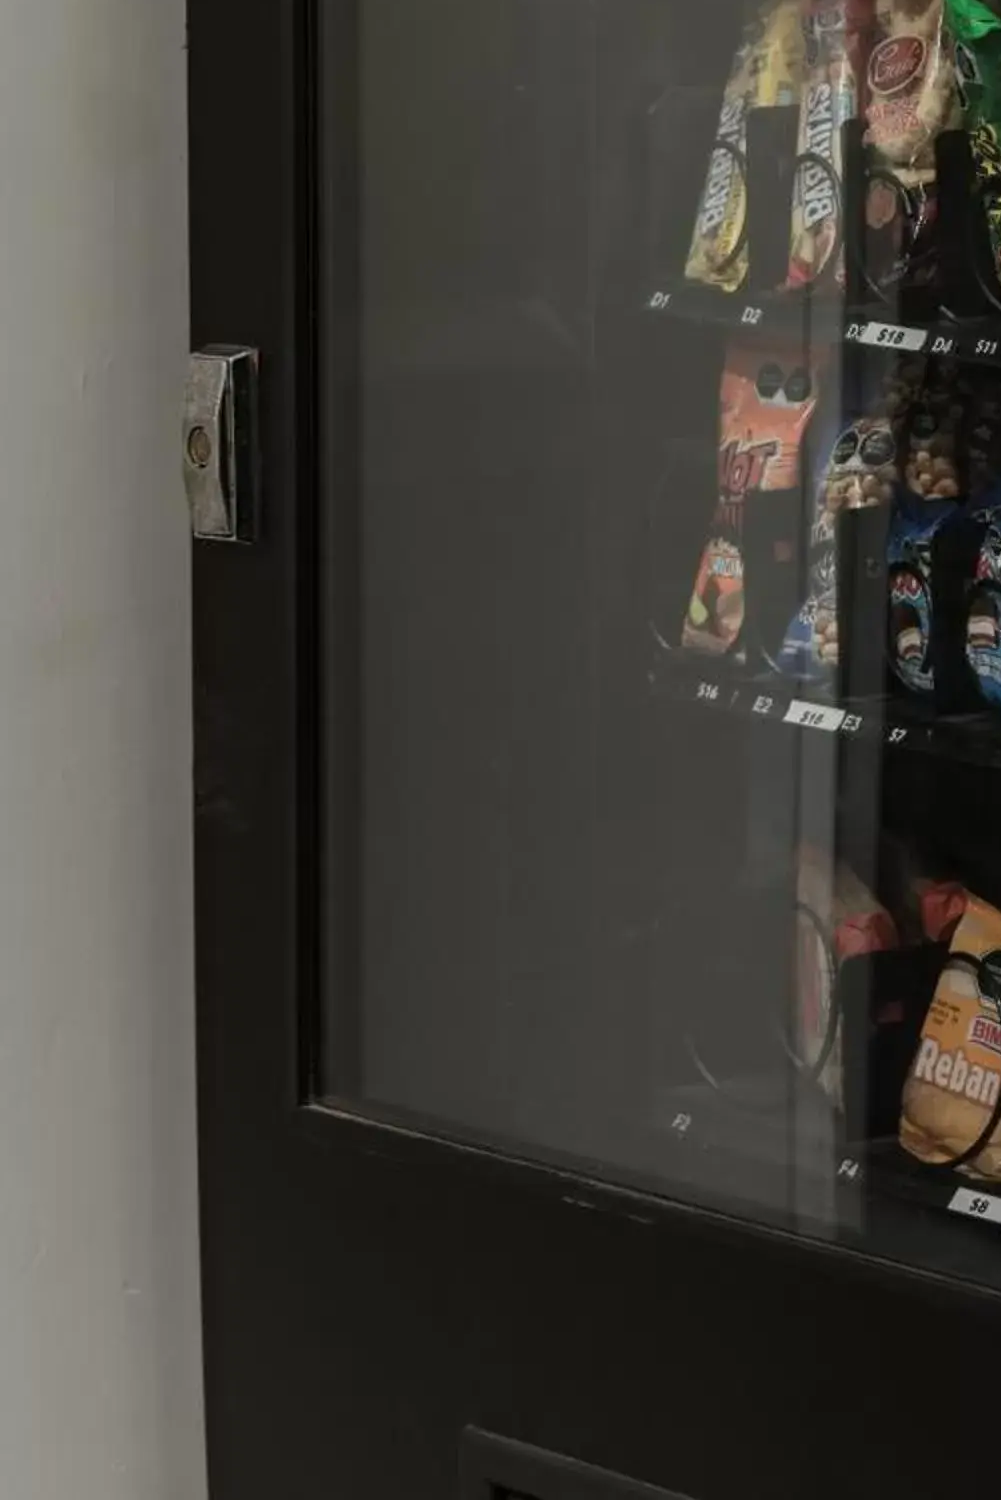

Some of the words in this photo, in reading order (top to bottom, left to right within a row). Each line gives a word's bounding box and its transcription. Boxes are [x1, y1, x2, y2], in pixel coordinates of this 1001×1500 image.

[650, 291, 672, 308] D1
[740, 306, 763, 325] D2
[876, 327, 904, 345] $18
[931, 336, 954, 354] D4
[751, 695, 774, 714] E2
[837, 1158, 860, 1178] F4
[969, 1197, 991, 1214] $8
